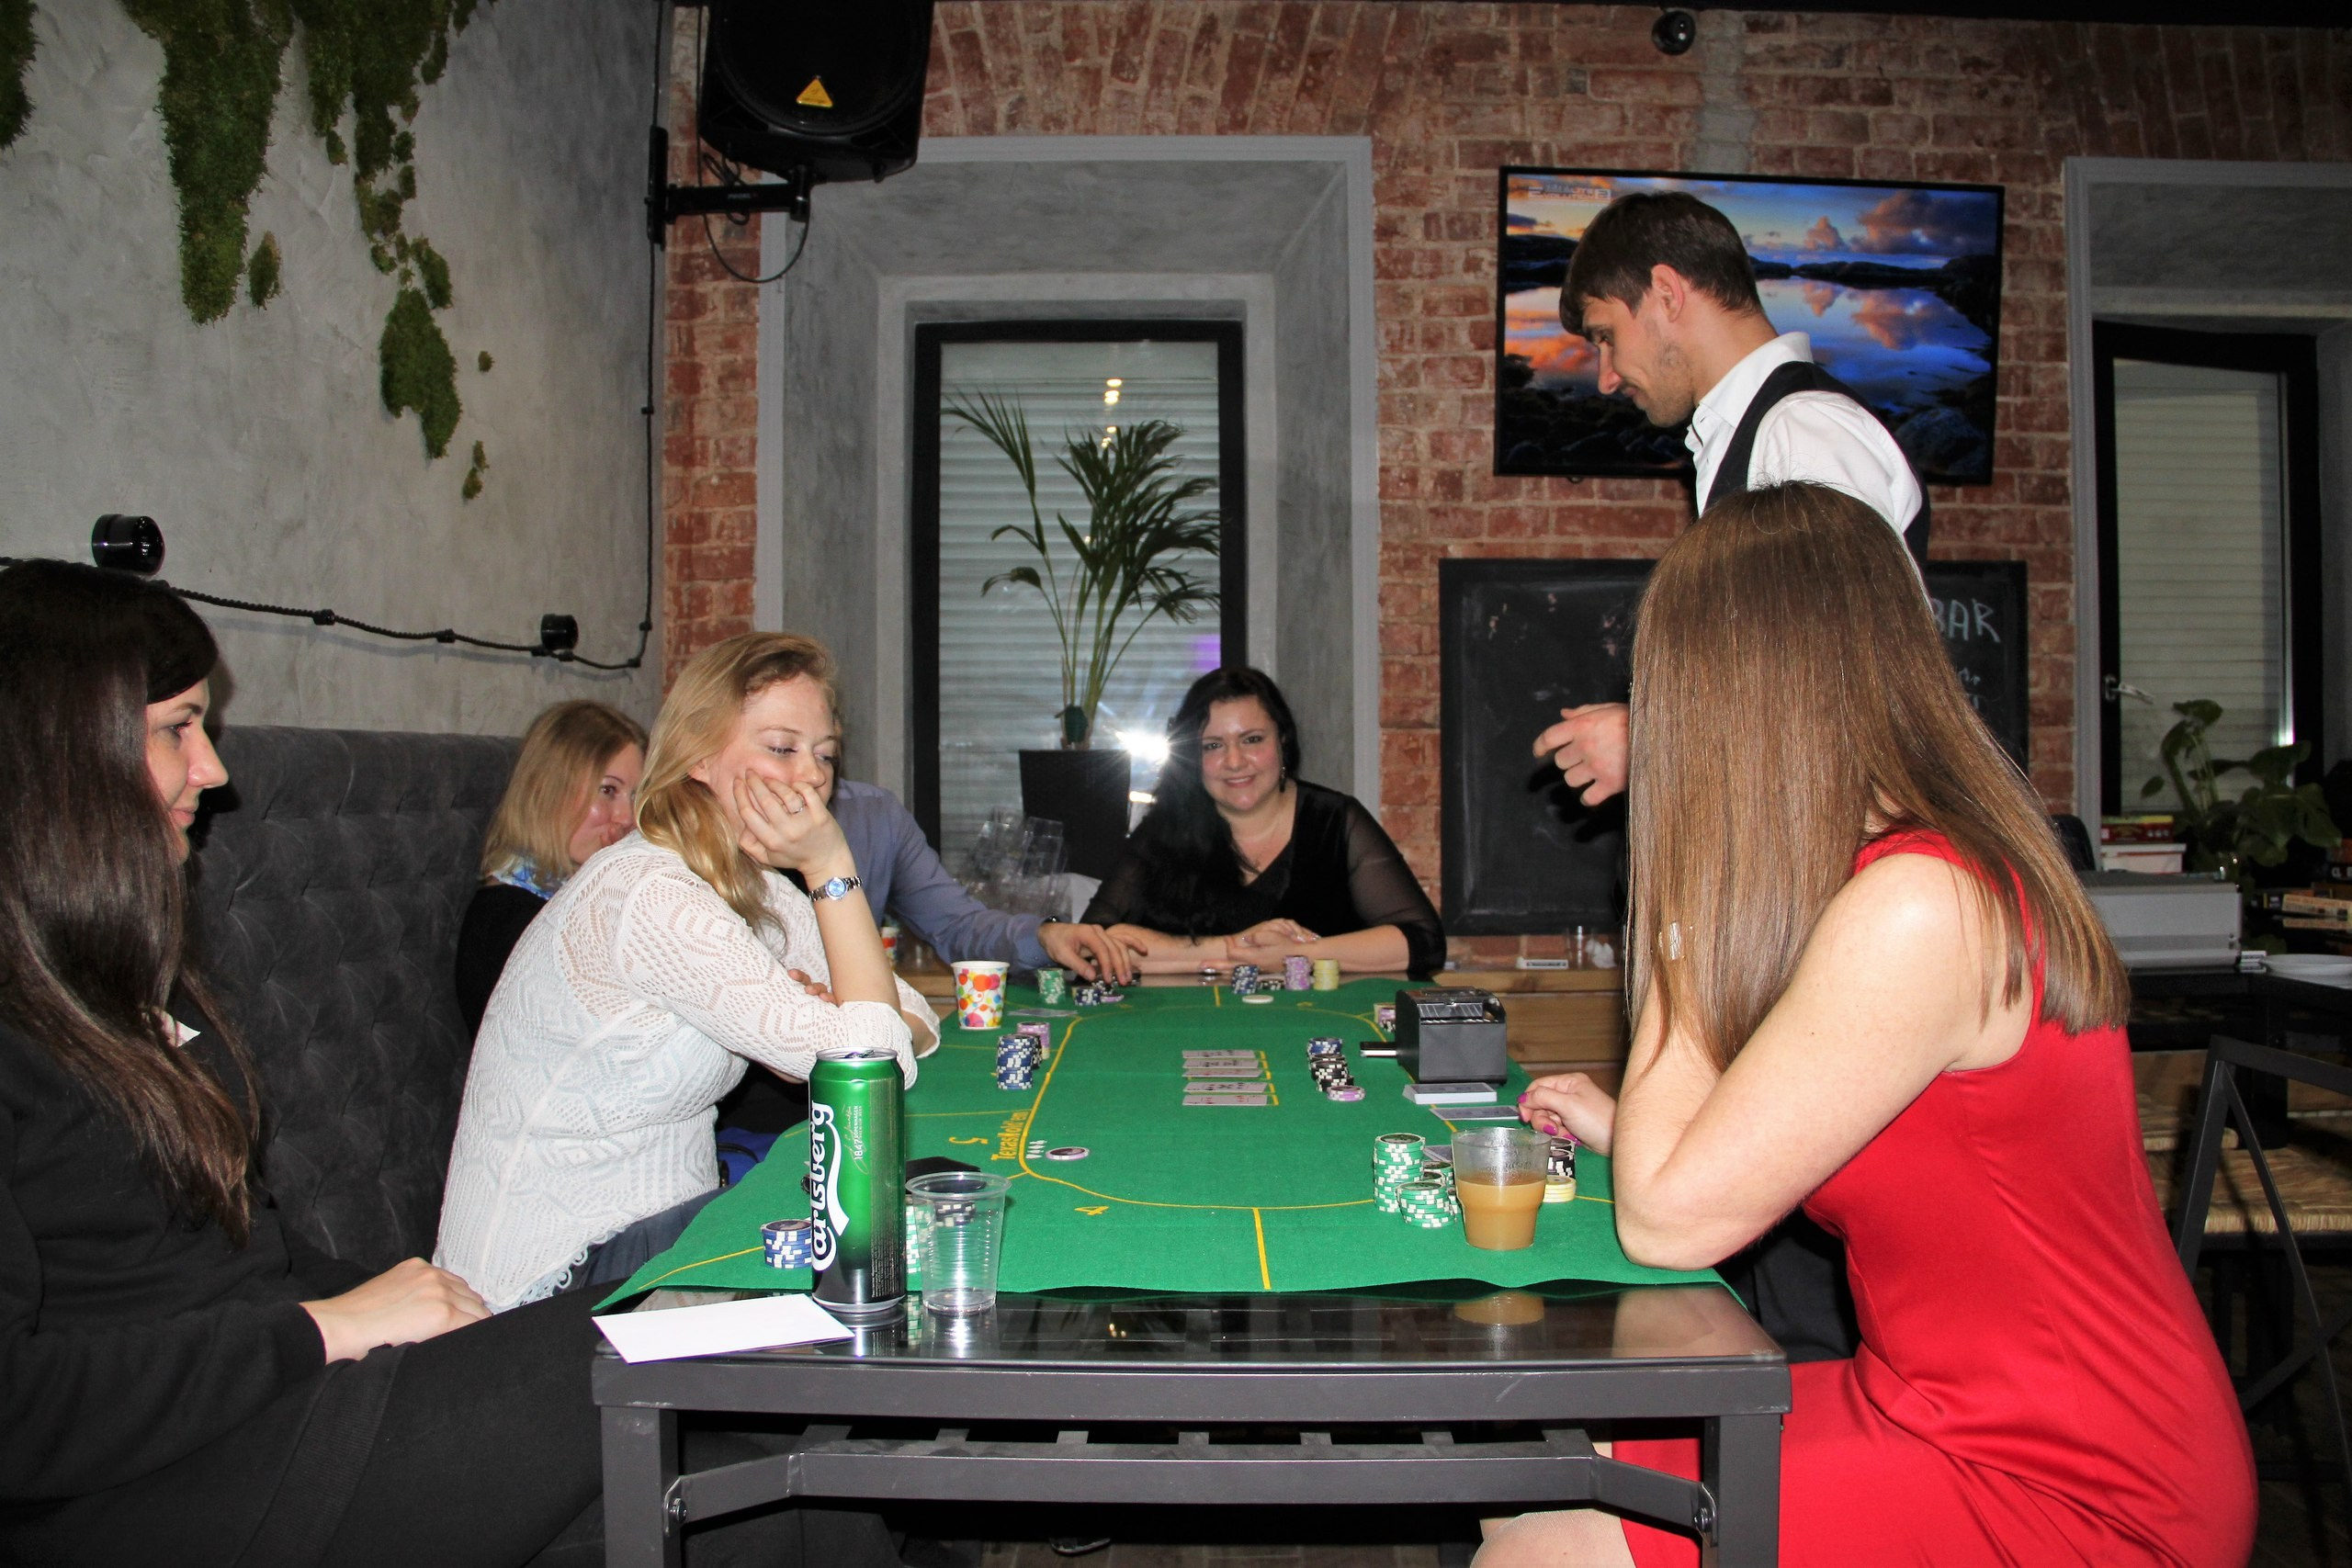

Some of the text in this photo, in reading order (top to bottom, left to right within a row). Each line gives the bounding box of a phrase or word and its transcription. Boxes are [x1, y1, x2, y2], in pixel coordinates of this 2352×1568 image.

[854, 1139, 864, 1160] 1847
[810, 1100, 837, 1271] Carlsberg
[1074, 1205, 1109, 1215] 4
